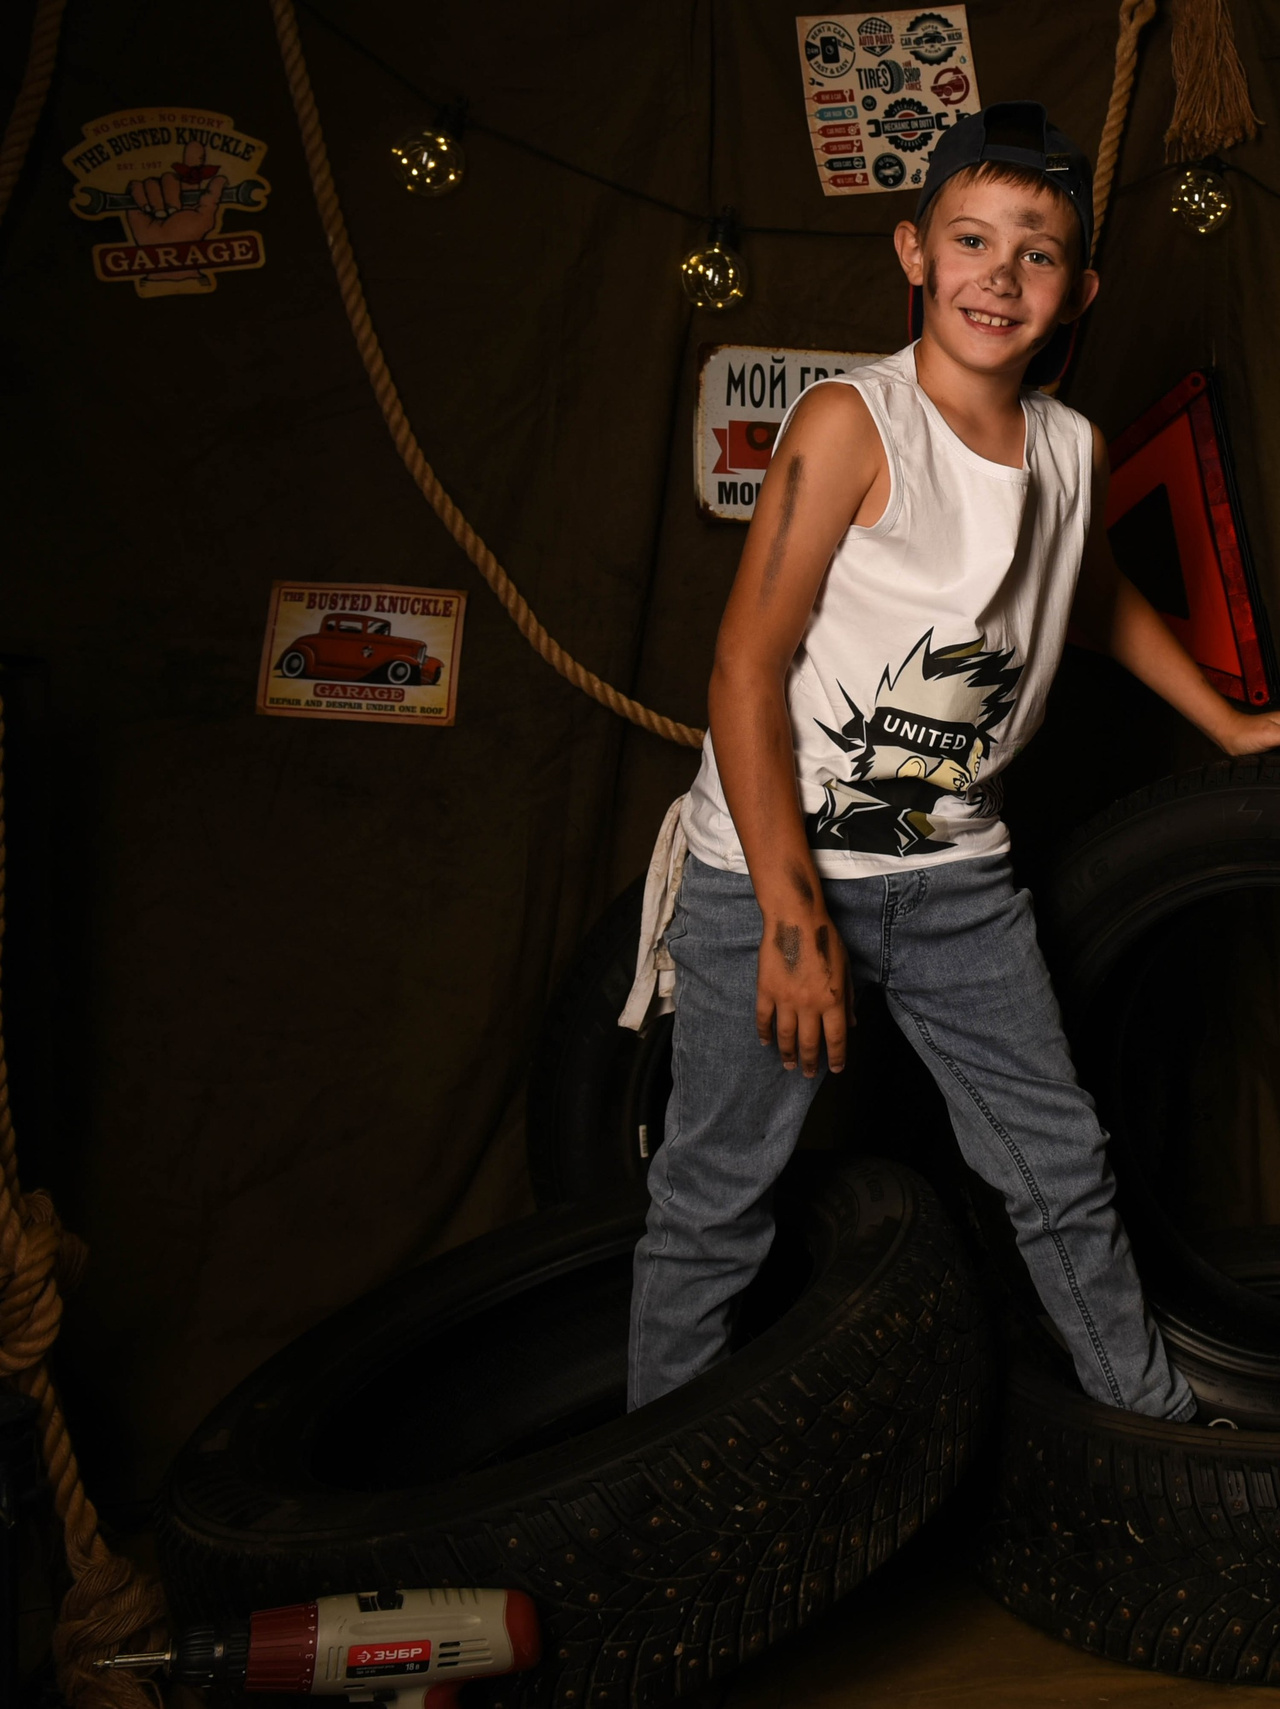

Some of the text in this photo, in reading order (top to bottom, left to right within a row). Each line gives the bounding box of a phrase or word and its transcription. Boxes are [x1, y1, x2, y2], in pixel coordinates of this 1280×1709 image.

[811, 26, 825, 40] RENT
[833, 27, 846, 39] CAR
[859, 34, 895, 46] AUTO PARTS
[900, 32, 963, 46] CAR WASH
[814, 60, 828, 73] FAST
[835, 59, 849, 73] EASY
[856, 67, 889, 90] TIRES
[904, 67, 921, 83] SHOP
[93, 114, 224, 136] NO SCAR NO STORY
[919, 119, 933, 128] DUTY
[73, 127, 256, 173] THE BUSTED KNUCKLE
[105, 240, 253, 272] GARAGE
[726, 355, 787, 409] МОЙ
[283, 591, 453, 617] THE BUSTED KNUCKLE
[315, 684, 403, 701] GARAGE
[269, 697, 443, 715] REPAIR AND DESPAIR UNDER ONE ROOF
[883, 713, 967, 751] UNITED
[373, 1647, 423, 1661] ЗУБР
[405, 1663, 414, 1671] 18
